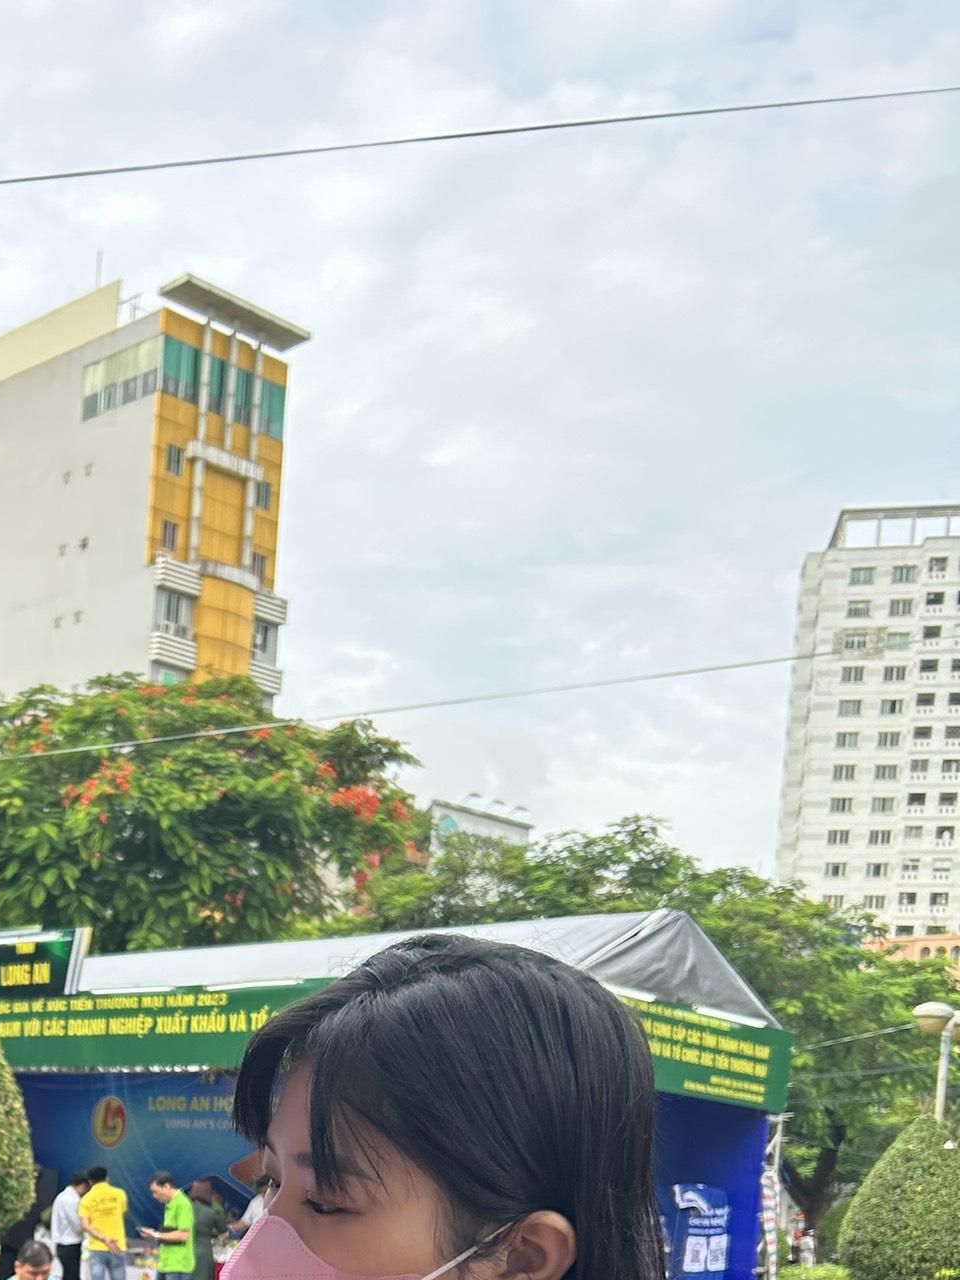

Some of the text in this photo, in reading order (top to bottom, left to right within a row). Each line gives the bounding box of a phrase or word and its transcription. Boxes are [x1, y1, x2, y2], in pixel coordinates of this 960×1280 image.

[0, 961, 50, 986] LONG AN
[148, 1095, 187, 1111] LONG
